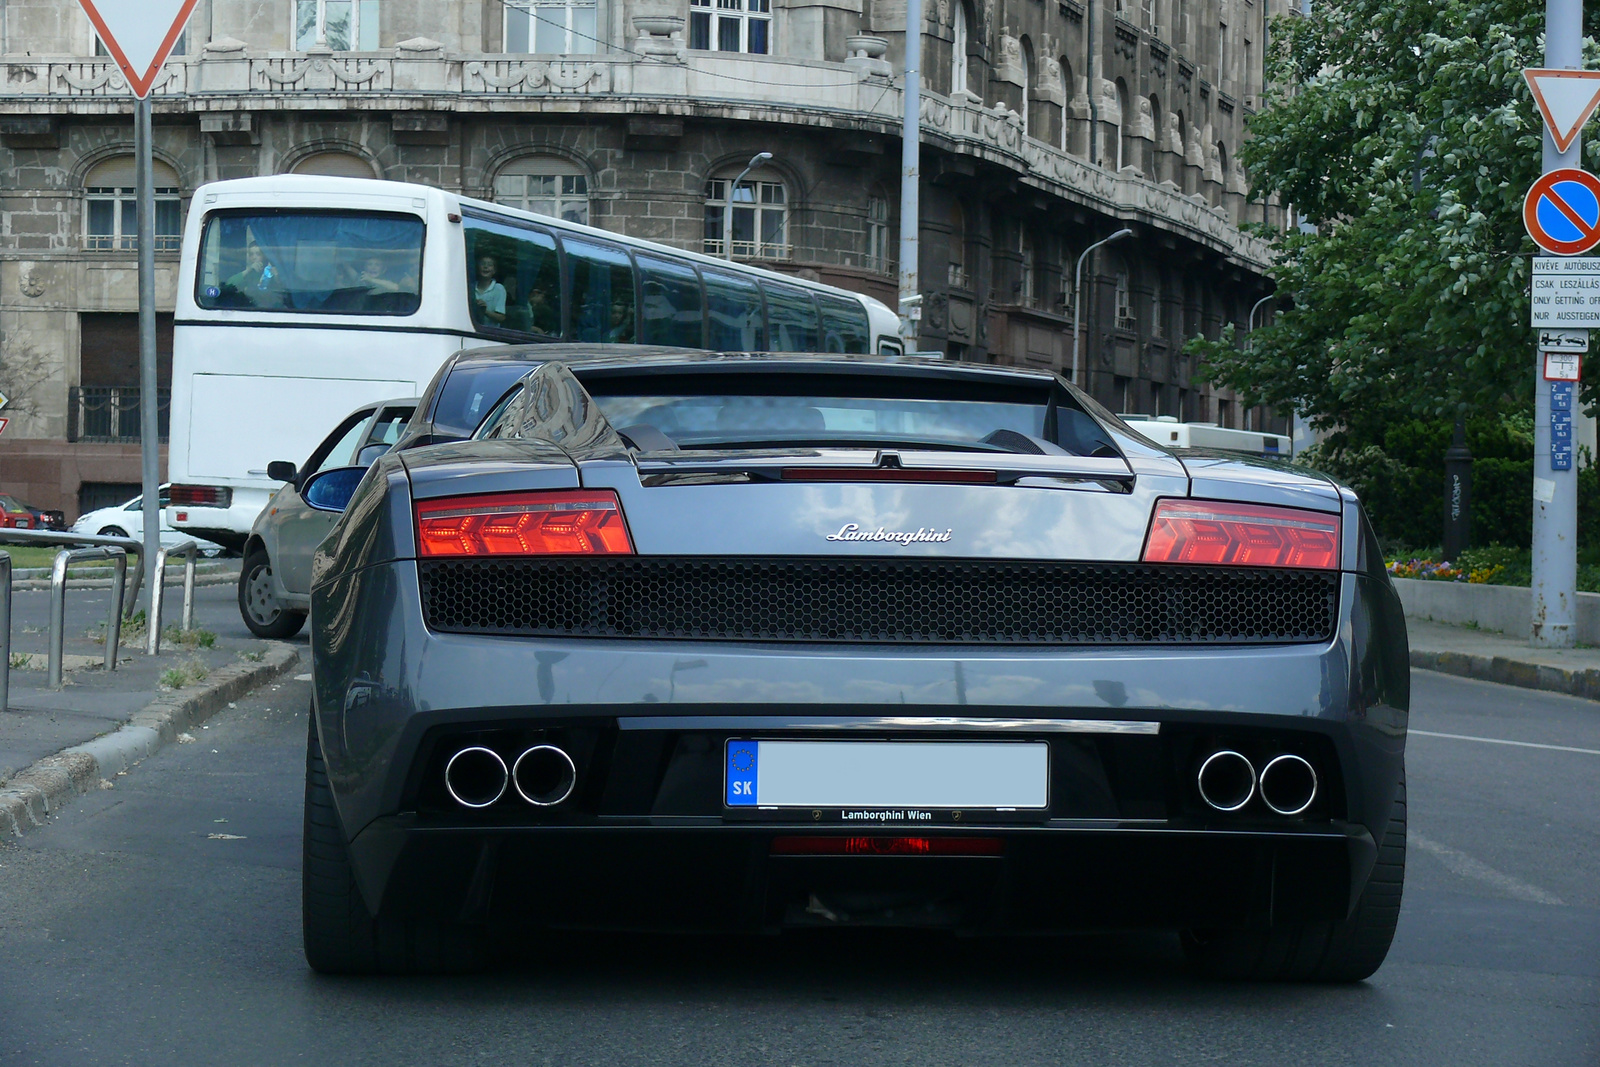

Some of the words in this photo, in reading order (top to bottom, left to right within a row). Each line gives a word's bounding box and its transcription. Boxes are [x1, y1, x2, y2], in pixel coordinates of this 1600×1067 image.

[1534, 259, 1559, 270] KIVÉVE
[1535, 280, 1554, 288] CSAK
[1560, 278, 1600, 288] LESZÁLLÁS
[1534, 296, 1550, 304] ONLY
[1554, 296, 1584, 304] GETTING
[1534, 312, 1550, 320] NUR
[1556, 312, 1600, 320] AUSSTEIGEN
[1552, 384, 1557, 392] Z
[1552, 444, 1556, 452] Z
[826, 523, 952, 546] Lamborghini
[732, 780, 752, 795] SK
[841, 810, 904, 821] Lamborghini
[907, 810, 932, 820] Wien
